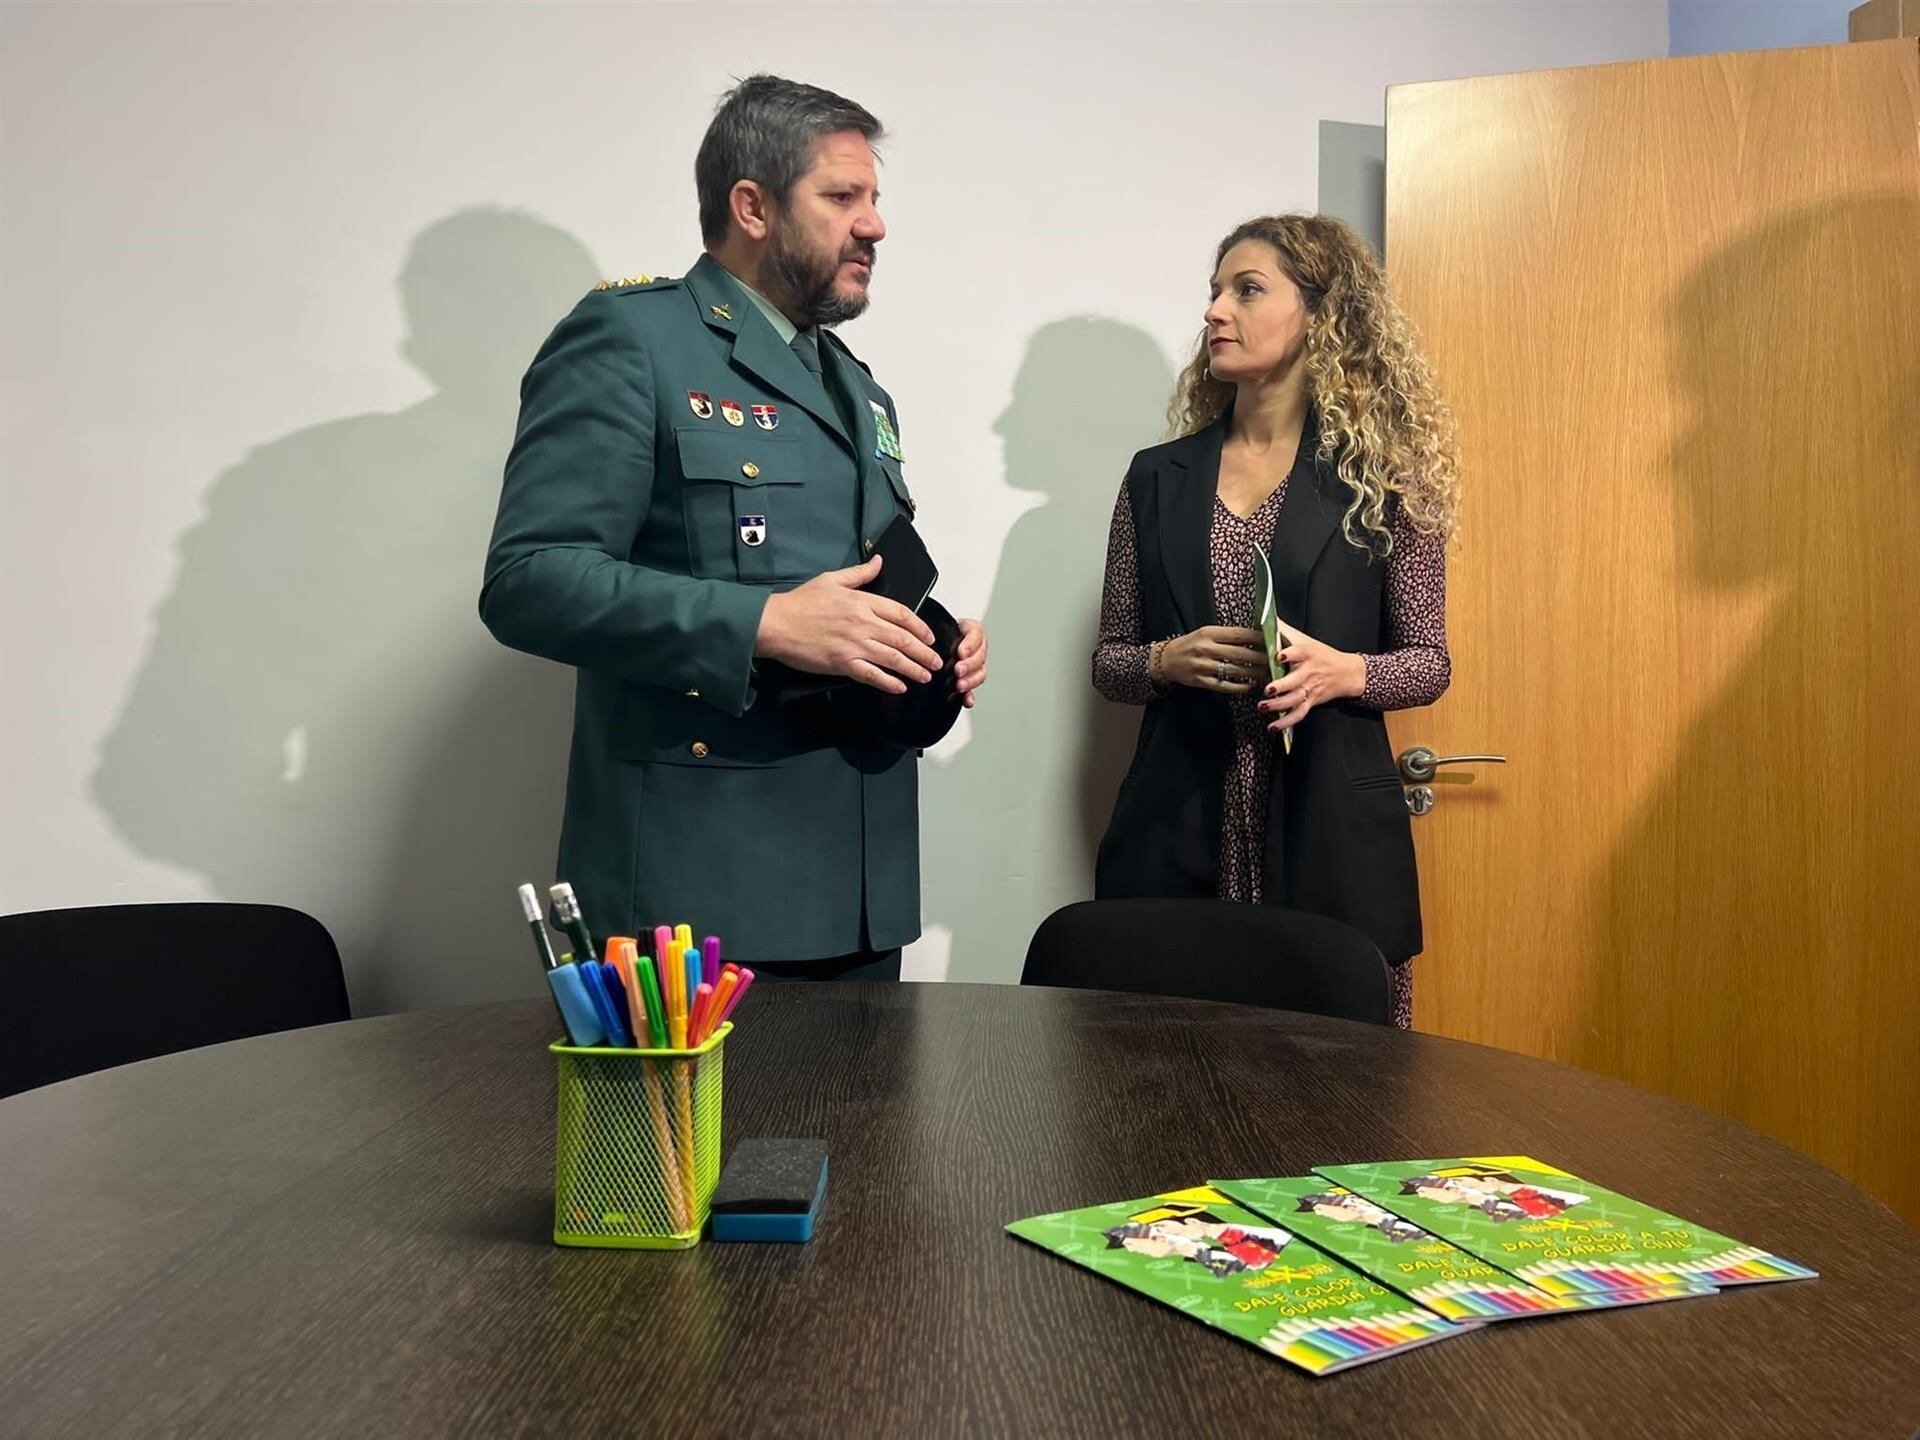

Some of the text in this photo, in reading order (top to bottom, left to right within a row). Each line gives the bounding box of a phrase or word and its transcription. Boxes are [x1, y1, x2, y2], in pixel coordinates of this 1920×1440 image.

[1502, 1230, 1690, 1252] DALE COLOR A TU
[1543, 1238, 1693, 1258] GUARDIA CIVIL
[1398, 1258, 1452, 1273] DALE
[1440, 1267, 1495, 1280] GUAR
[1233, 1291, 1288, 1312] DALE
[1294, 1276, 1354, 1299] COLOR
[1279, 1290, 1366, 1317] GUARDIA
